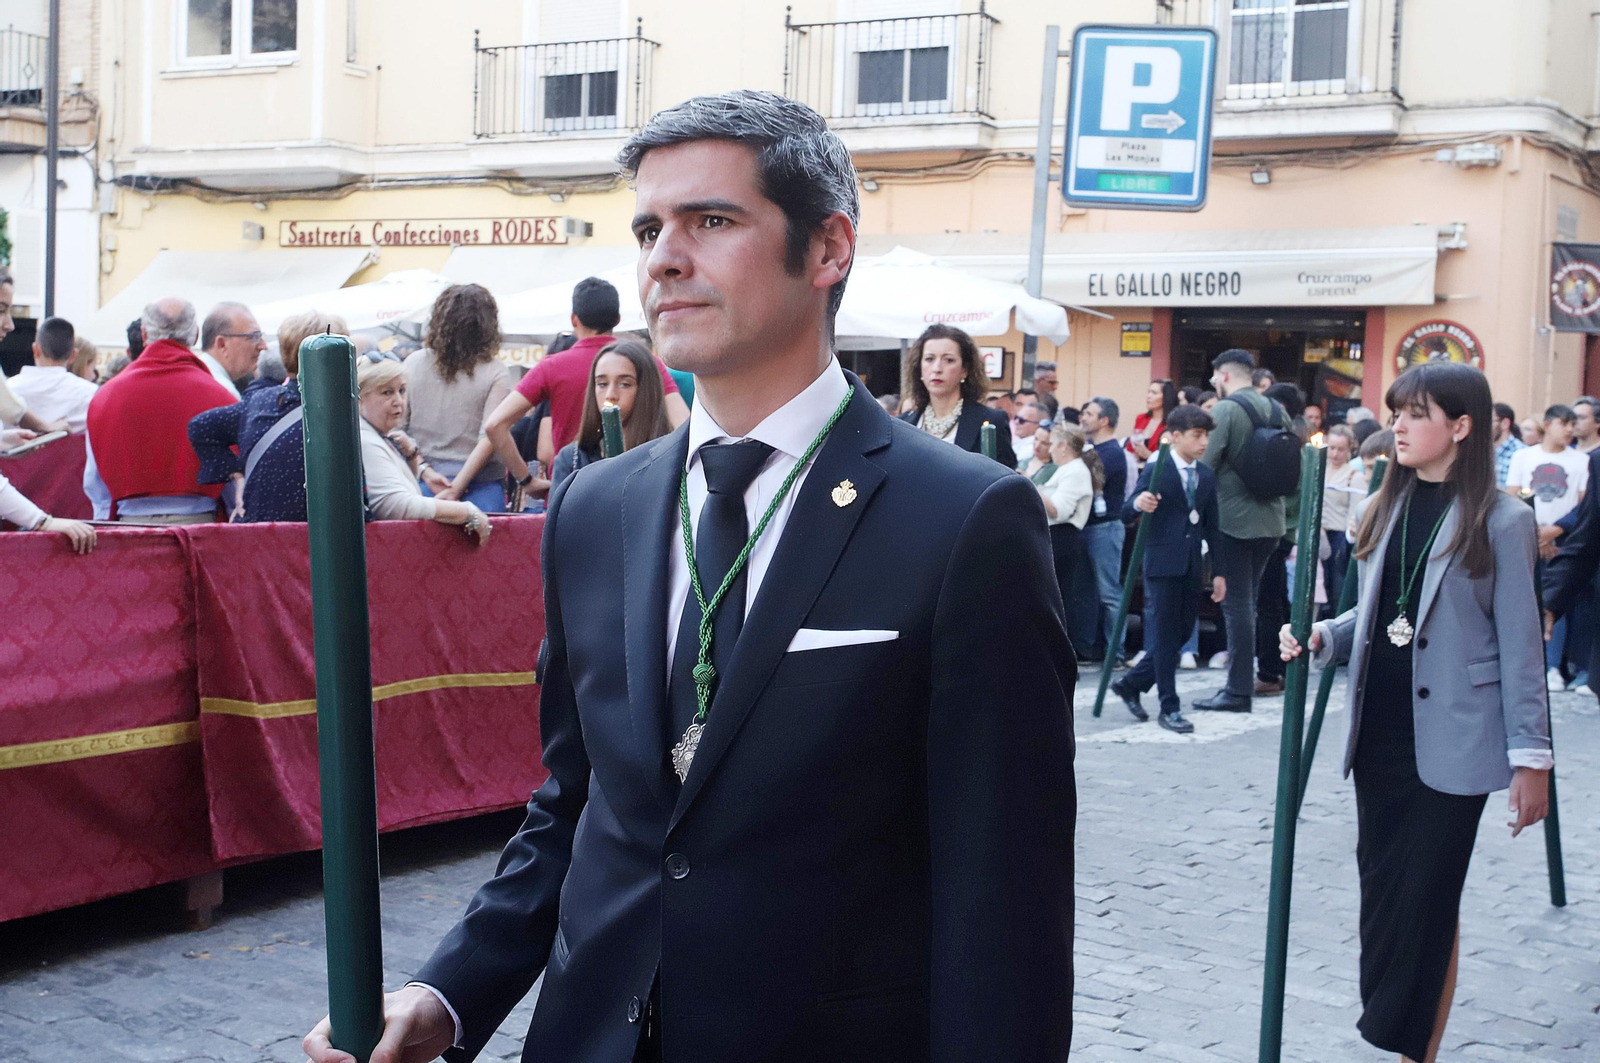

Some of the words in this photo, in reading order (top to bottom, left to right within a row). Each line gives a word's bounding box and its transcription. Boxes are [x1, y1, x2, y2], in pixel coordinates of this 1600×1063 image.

[1100, 45, 1182, 131] P
[1121, 141, 1147, 151] Plaza
[1105, 154, 1122, 162] Las
[1127, 154, 1161, 165] Monjas
[1111, 177, 1157, 191] LIBRE
[289, 220, 361, 246] Sastrería
[372, 221, 480, 247] Confecciones
[492, 217, 558, 245] RODES
[1088, 273, 1109, 297] EL
[1115, 272, 1172, 297] GALLO
[1180, 271, 1242, 296] NEGRO
[1298, 272, 1373, 286] Cruzcampo
[923, 310, 994, 323] Cruzcampo
